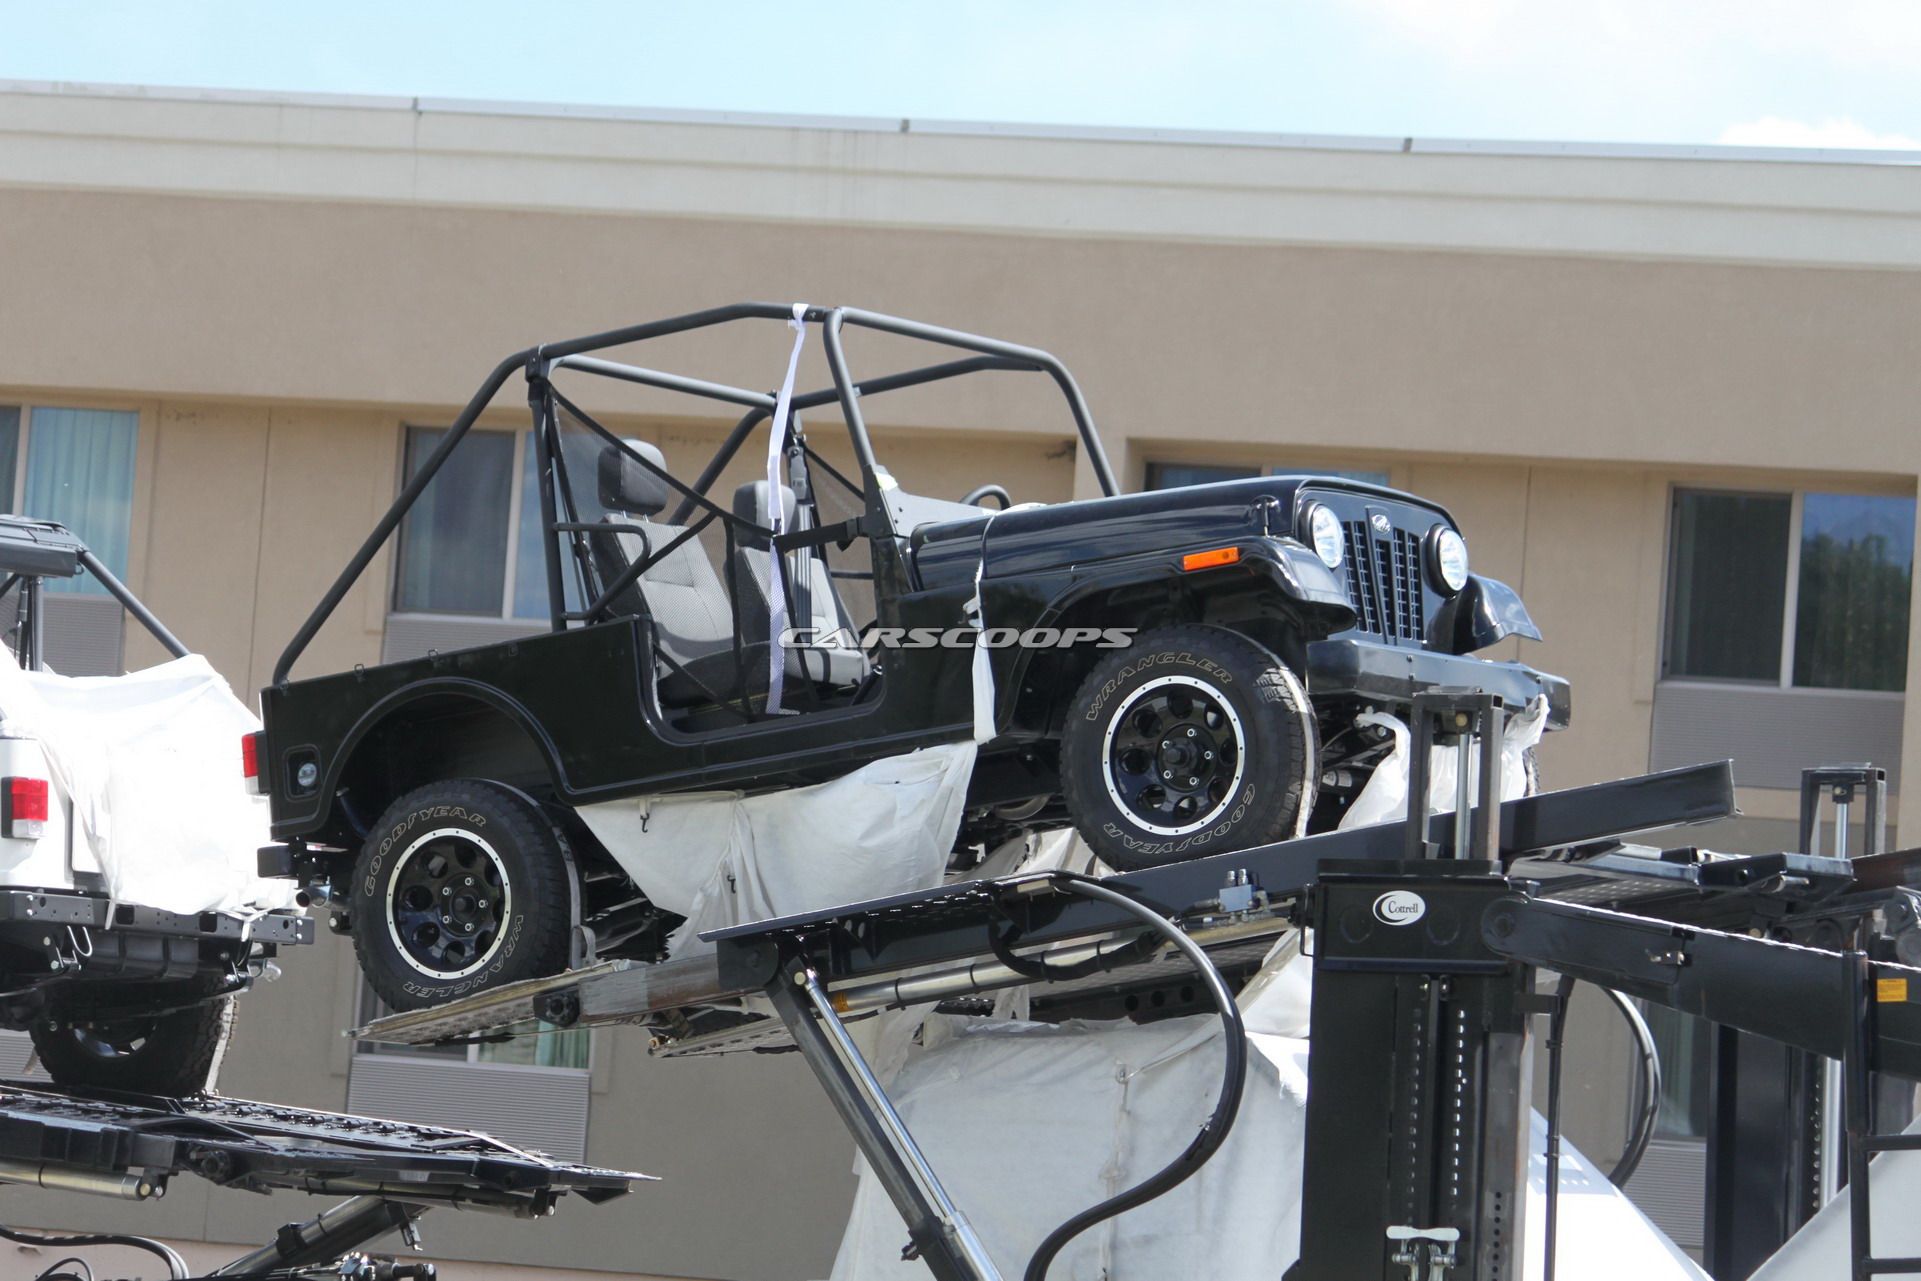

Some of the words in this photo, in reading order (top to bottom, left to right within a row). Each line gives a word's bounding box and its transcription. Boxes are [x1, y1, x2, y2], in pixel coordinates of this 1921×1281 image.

[1086, 652, 1233, 721] WRANGLER
[364, 806, 487, 897] GOODYEAR
[1103, 784, 1256, 855] GOODYEAR
[1387, 900, 1419, 914] Cottrell
[403, 914, 524, 998] WRANGLER
